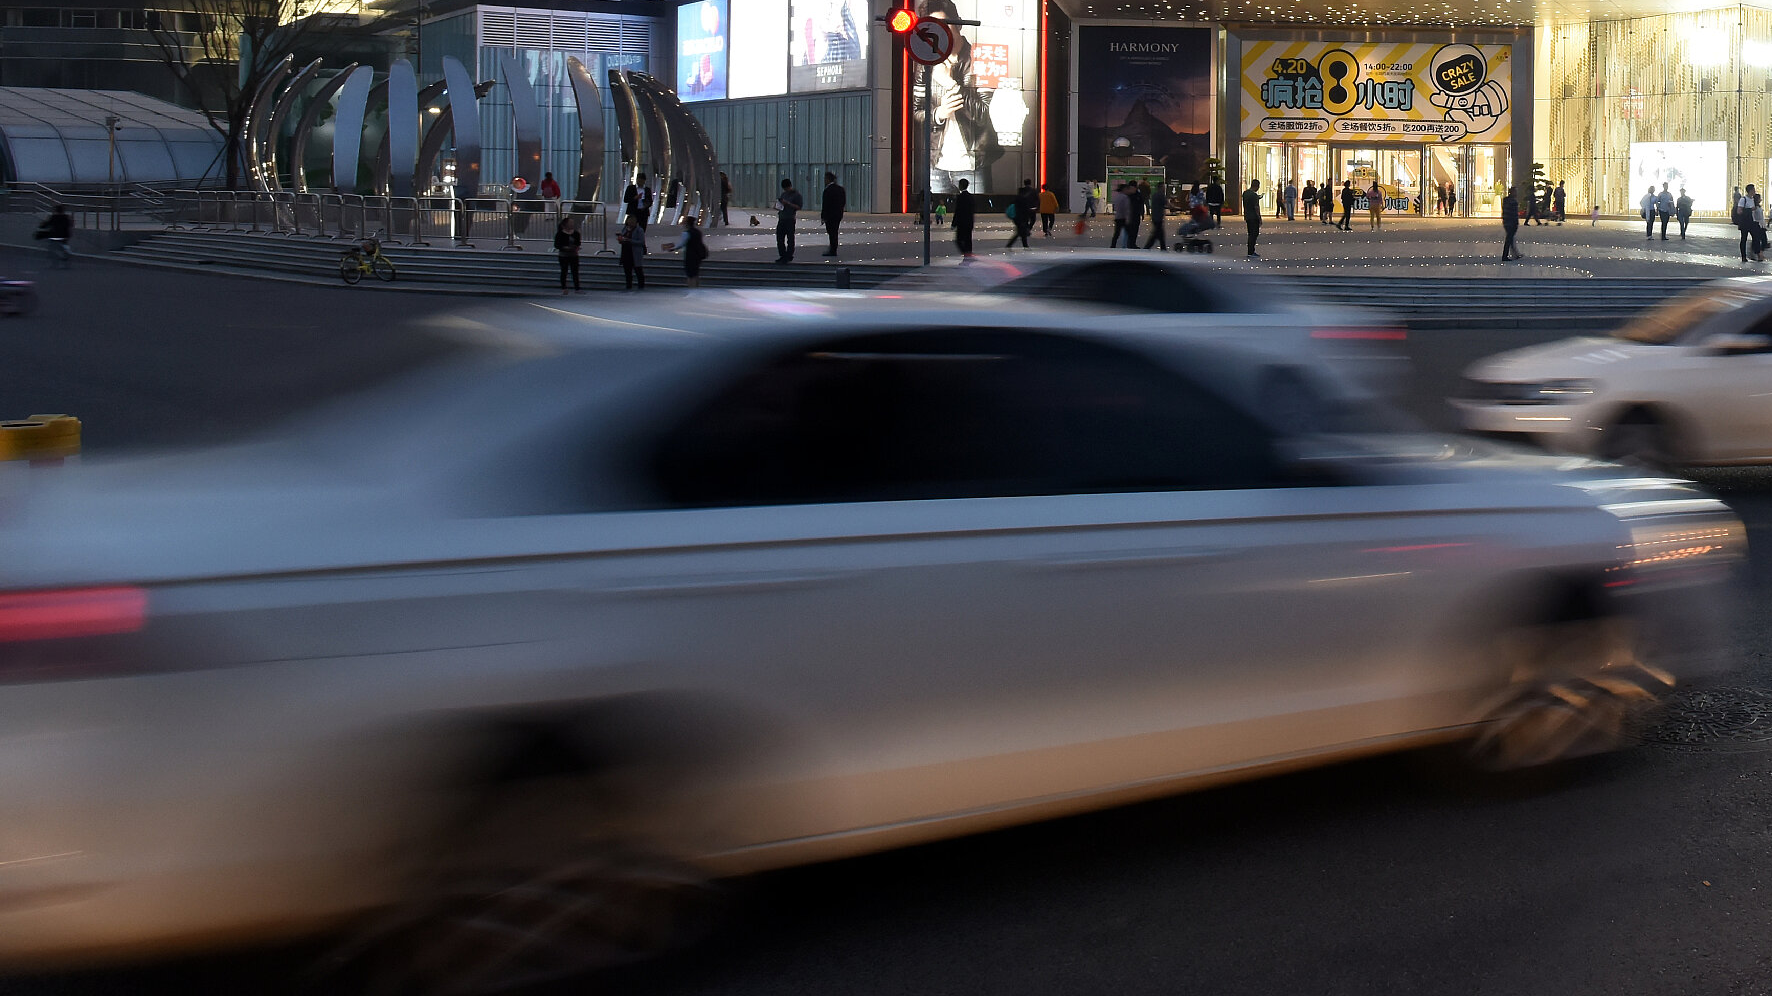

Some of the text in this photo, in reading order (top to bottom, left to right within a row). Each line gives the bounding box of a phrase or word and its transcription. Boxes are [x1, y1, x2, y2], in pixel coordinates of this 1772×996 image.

[1110, 42, 1180, 53] HARMONY
[1272, 59, 1307, 74] 4.20
[1441, 60, 1474, 81] CRAZY
[1261, 50, 1415, 115] 疯抢8小时
[1450, 72, 1477, 90] SALE
